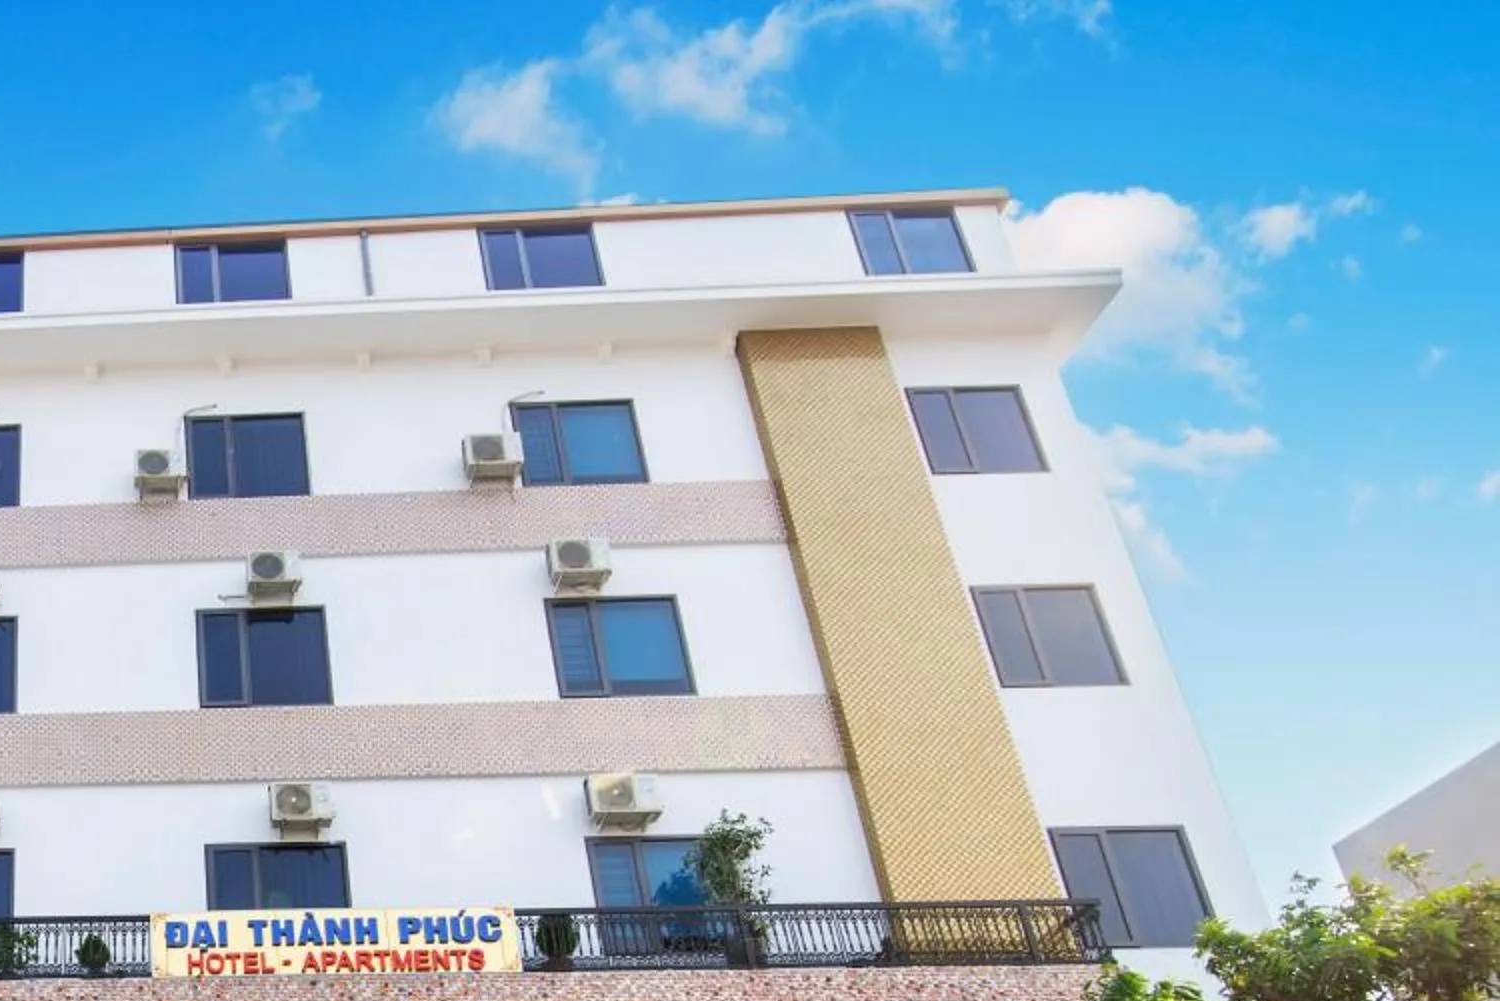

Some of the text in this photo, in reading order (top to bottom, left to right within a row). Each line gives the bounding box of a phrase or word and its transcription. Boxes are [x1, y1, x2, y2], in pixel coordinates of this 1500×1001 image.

[165, 910, 503, 952] ĐẠI THÀNH PHÚC
[187, 951, 275, 975] HOTEL
[301, 949, 486, 973] APARTMENTS
